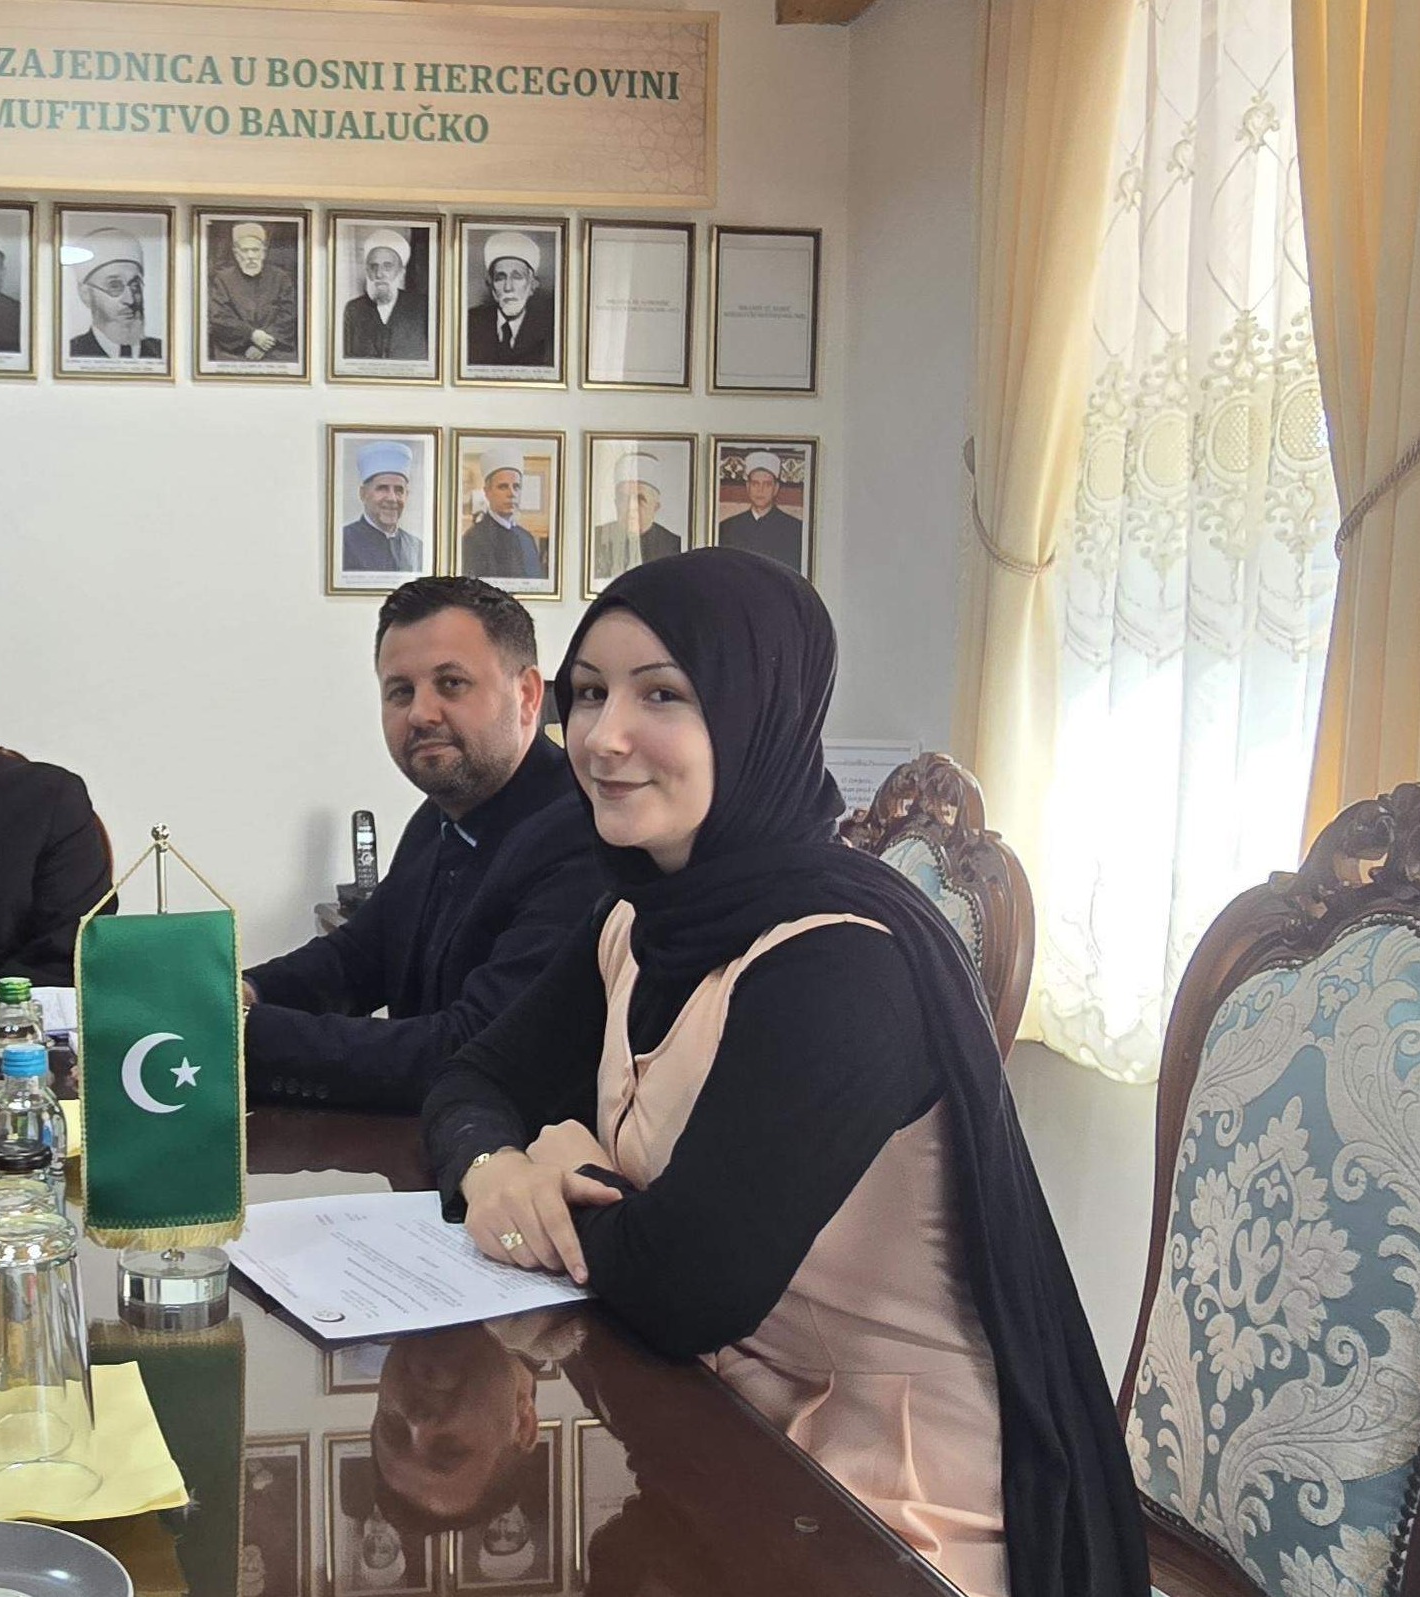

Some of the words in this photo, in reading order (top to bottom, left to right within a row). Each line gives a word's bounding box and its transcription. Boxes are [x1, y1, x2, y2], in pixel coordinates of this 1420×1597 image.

[230, 56, 259, 87] U
[265, 57, 385, 91] BOSNI
[392, 62, 406, 92] I
[413, 63, 681, 101] HERCEGOVINI
[239, 104, 489, 144] BANJALUČKO
